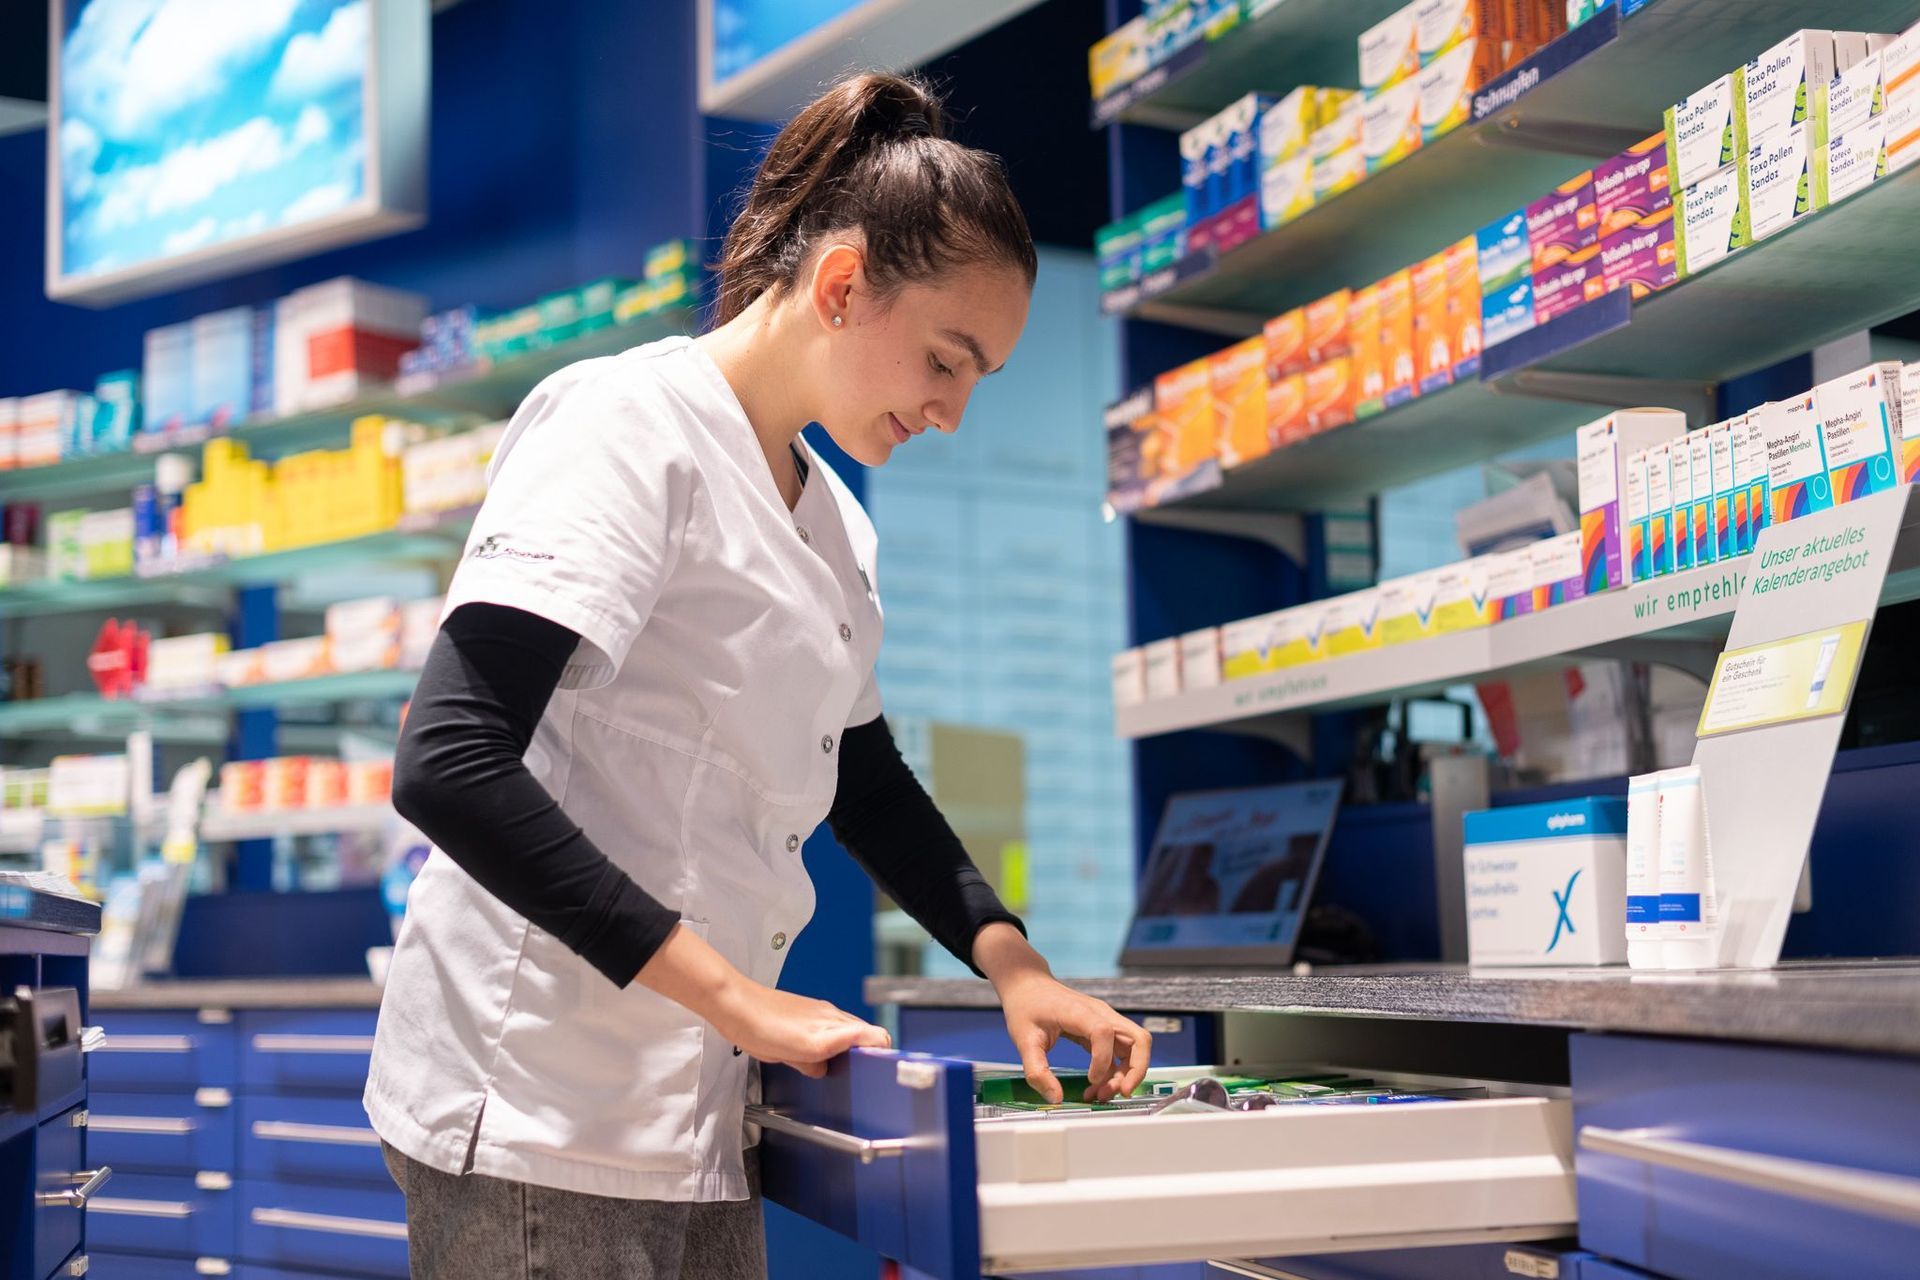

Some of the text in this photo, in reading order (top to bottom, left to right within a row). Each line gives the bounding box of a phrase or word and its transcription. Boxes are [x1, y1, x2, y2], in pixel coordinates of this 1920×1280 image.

[1747, 71, 1766, 88] Fexo
[1766, 55, 1792, 77] Pollen
[1473, 66, 1540, 119] Schnupfen
[1747, 79, 1777, 104] Sandoz
[1677, 98, 1718, 128] Fexo Pollen
[1830, 96, 1853, 114] Sandoz
[1678, 121, 1705, 143] Sandoz
[1750, 145, 1794, 177] Fexo Pollen
[1830, 158, 1855, 176] Sandoz
[1751, 169, 1779, 191] Sandoz
[1686, 184, 1728, 212] Fexo Pollen
[1687, 206, 1714, 227] Sandoz
[1826, 427, 1850, 441] Pastillen
[1768, 447, 1789, 461] Pastillen
[1789, 439, 1812, 454] Menthol
[1760, 526, 1866, 569] Unser aktuelles
[1752, 549, 1870, 596] Kalenderangebot
[1634, 594, 1659, 619] wir
[1724, 657, 1756, 673] Gutschein
